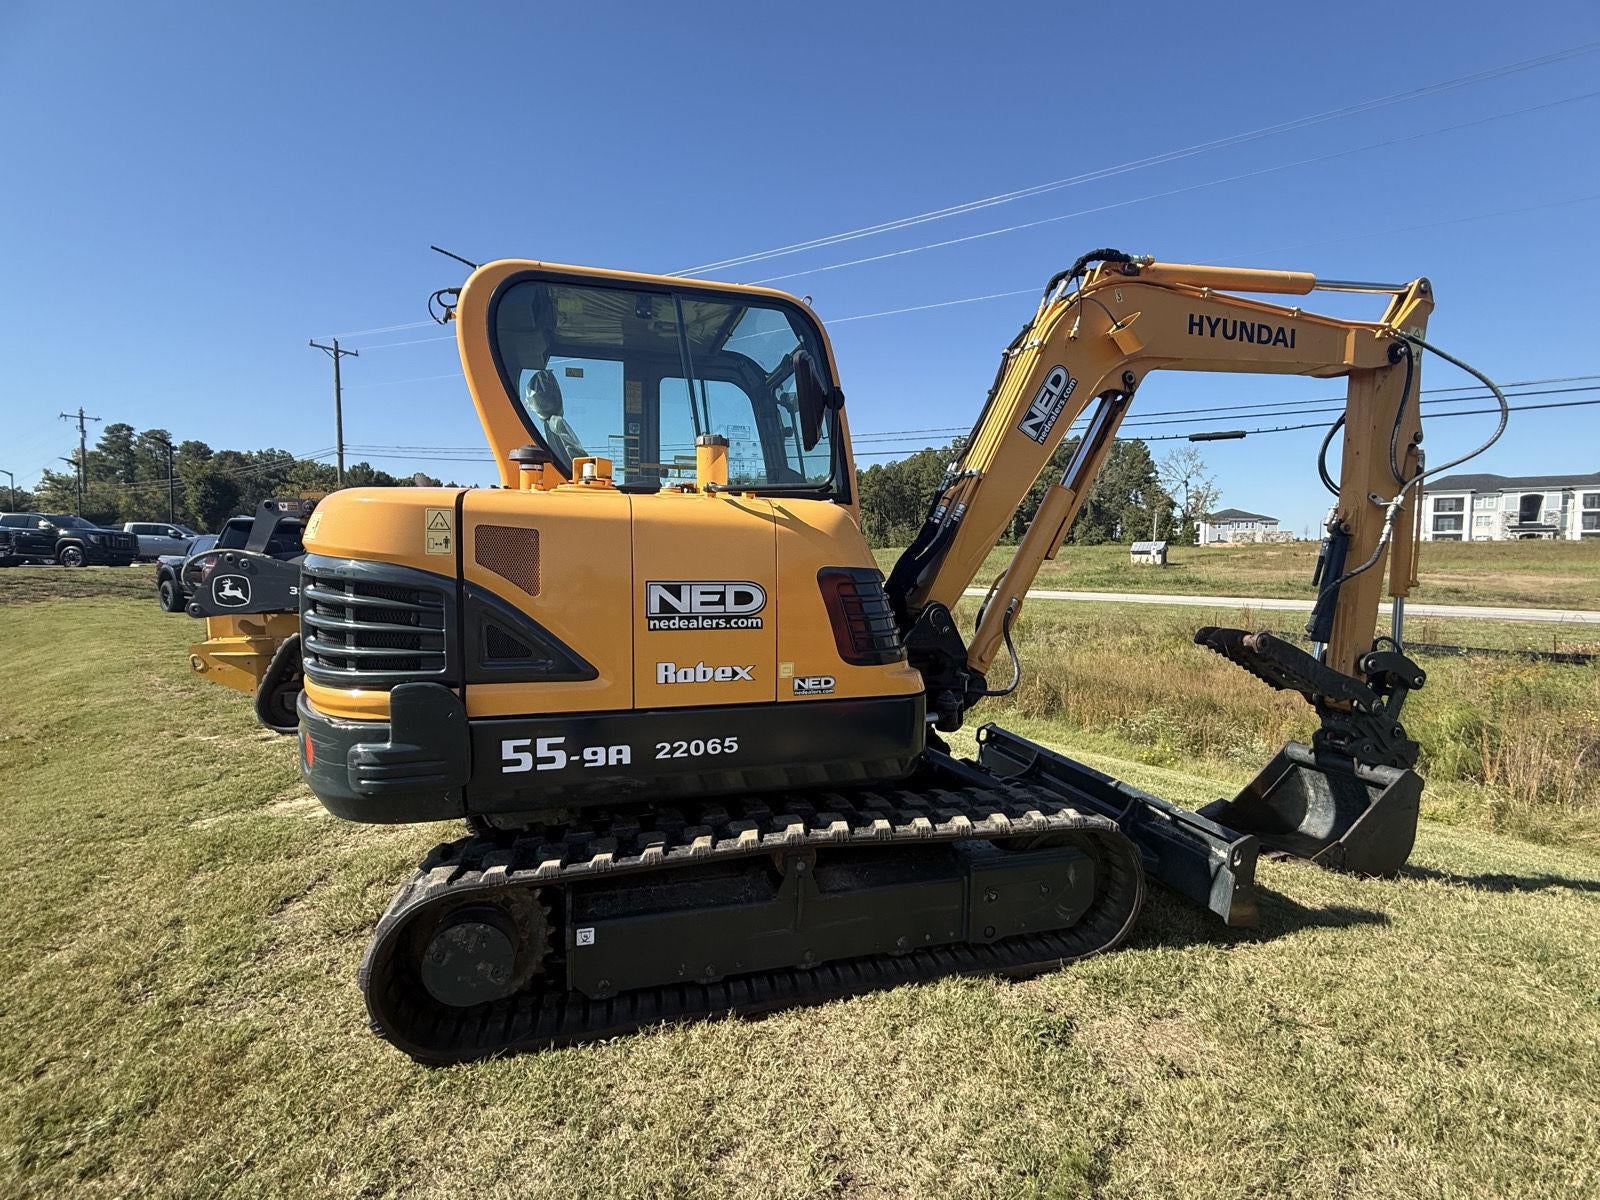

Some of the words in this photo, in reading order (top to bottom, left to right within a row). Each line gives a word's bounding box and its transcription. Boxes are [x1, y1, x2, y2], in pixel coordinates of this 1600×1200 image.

[1188, 313, 1296, 349] HYUNDAI
[1020, 367, 1068, 440] NED
[1038, 379, 1077, 443] nedealers.com
[290, 586, 301, 595] 3
[650, 583, 764, 613] NED
[649, 616, 762, 629] nedealers.com
[656, 661, 756, 684] Robex
[794, 677, 835, 690] NED
[501, 736, 631, 773] 55-9A
[655, 736, 739, 760] 22065
